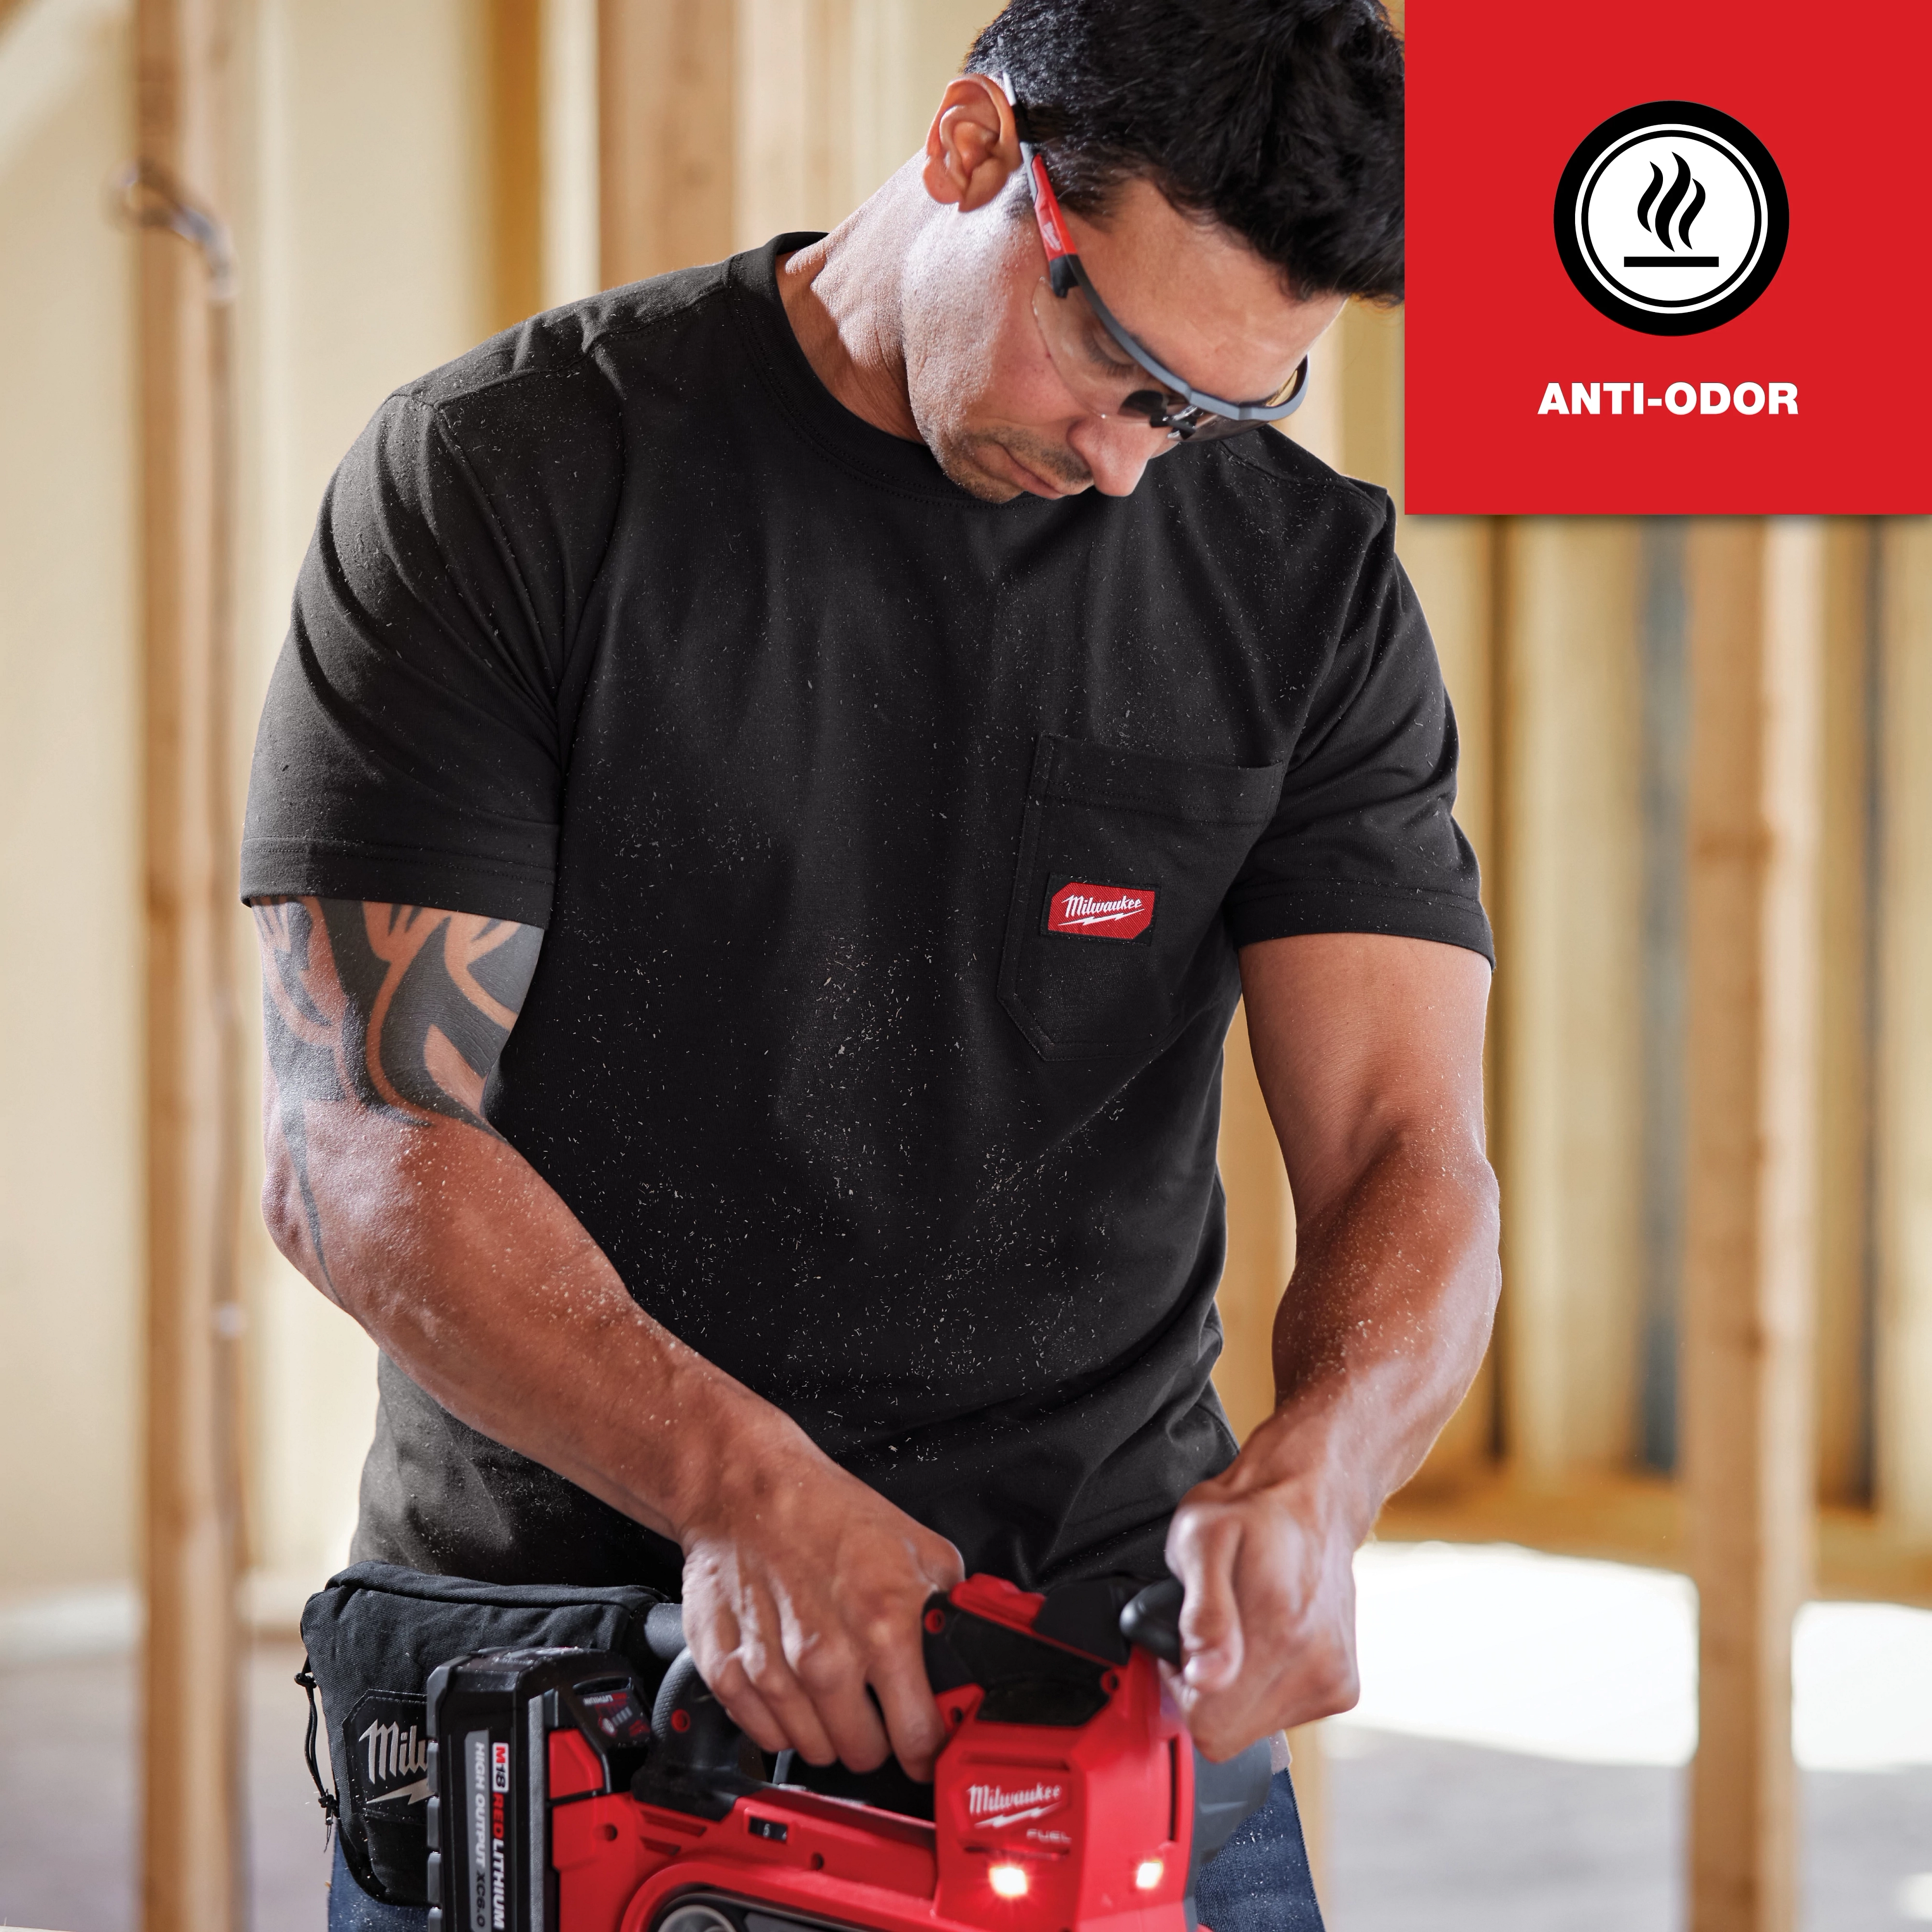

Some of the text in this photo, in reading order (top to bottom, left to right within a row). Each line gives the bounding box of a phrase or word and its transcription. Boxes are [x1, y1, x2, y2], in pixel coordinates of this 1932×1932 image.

[1061, 894, 1142, 918] Milwaukee
[475, 1742, 485, 1790] HIGH
[495, 1745, 506, 1789] M18
[966, 1782, 1061, 1815] Milwaukee
[475, 1792, 485, 1869] OUTPUT
[1026, 1828, 1072, 1844] FUEL
